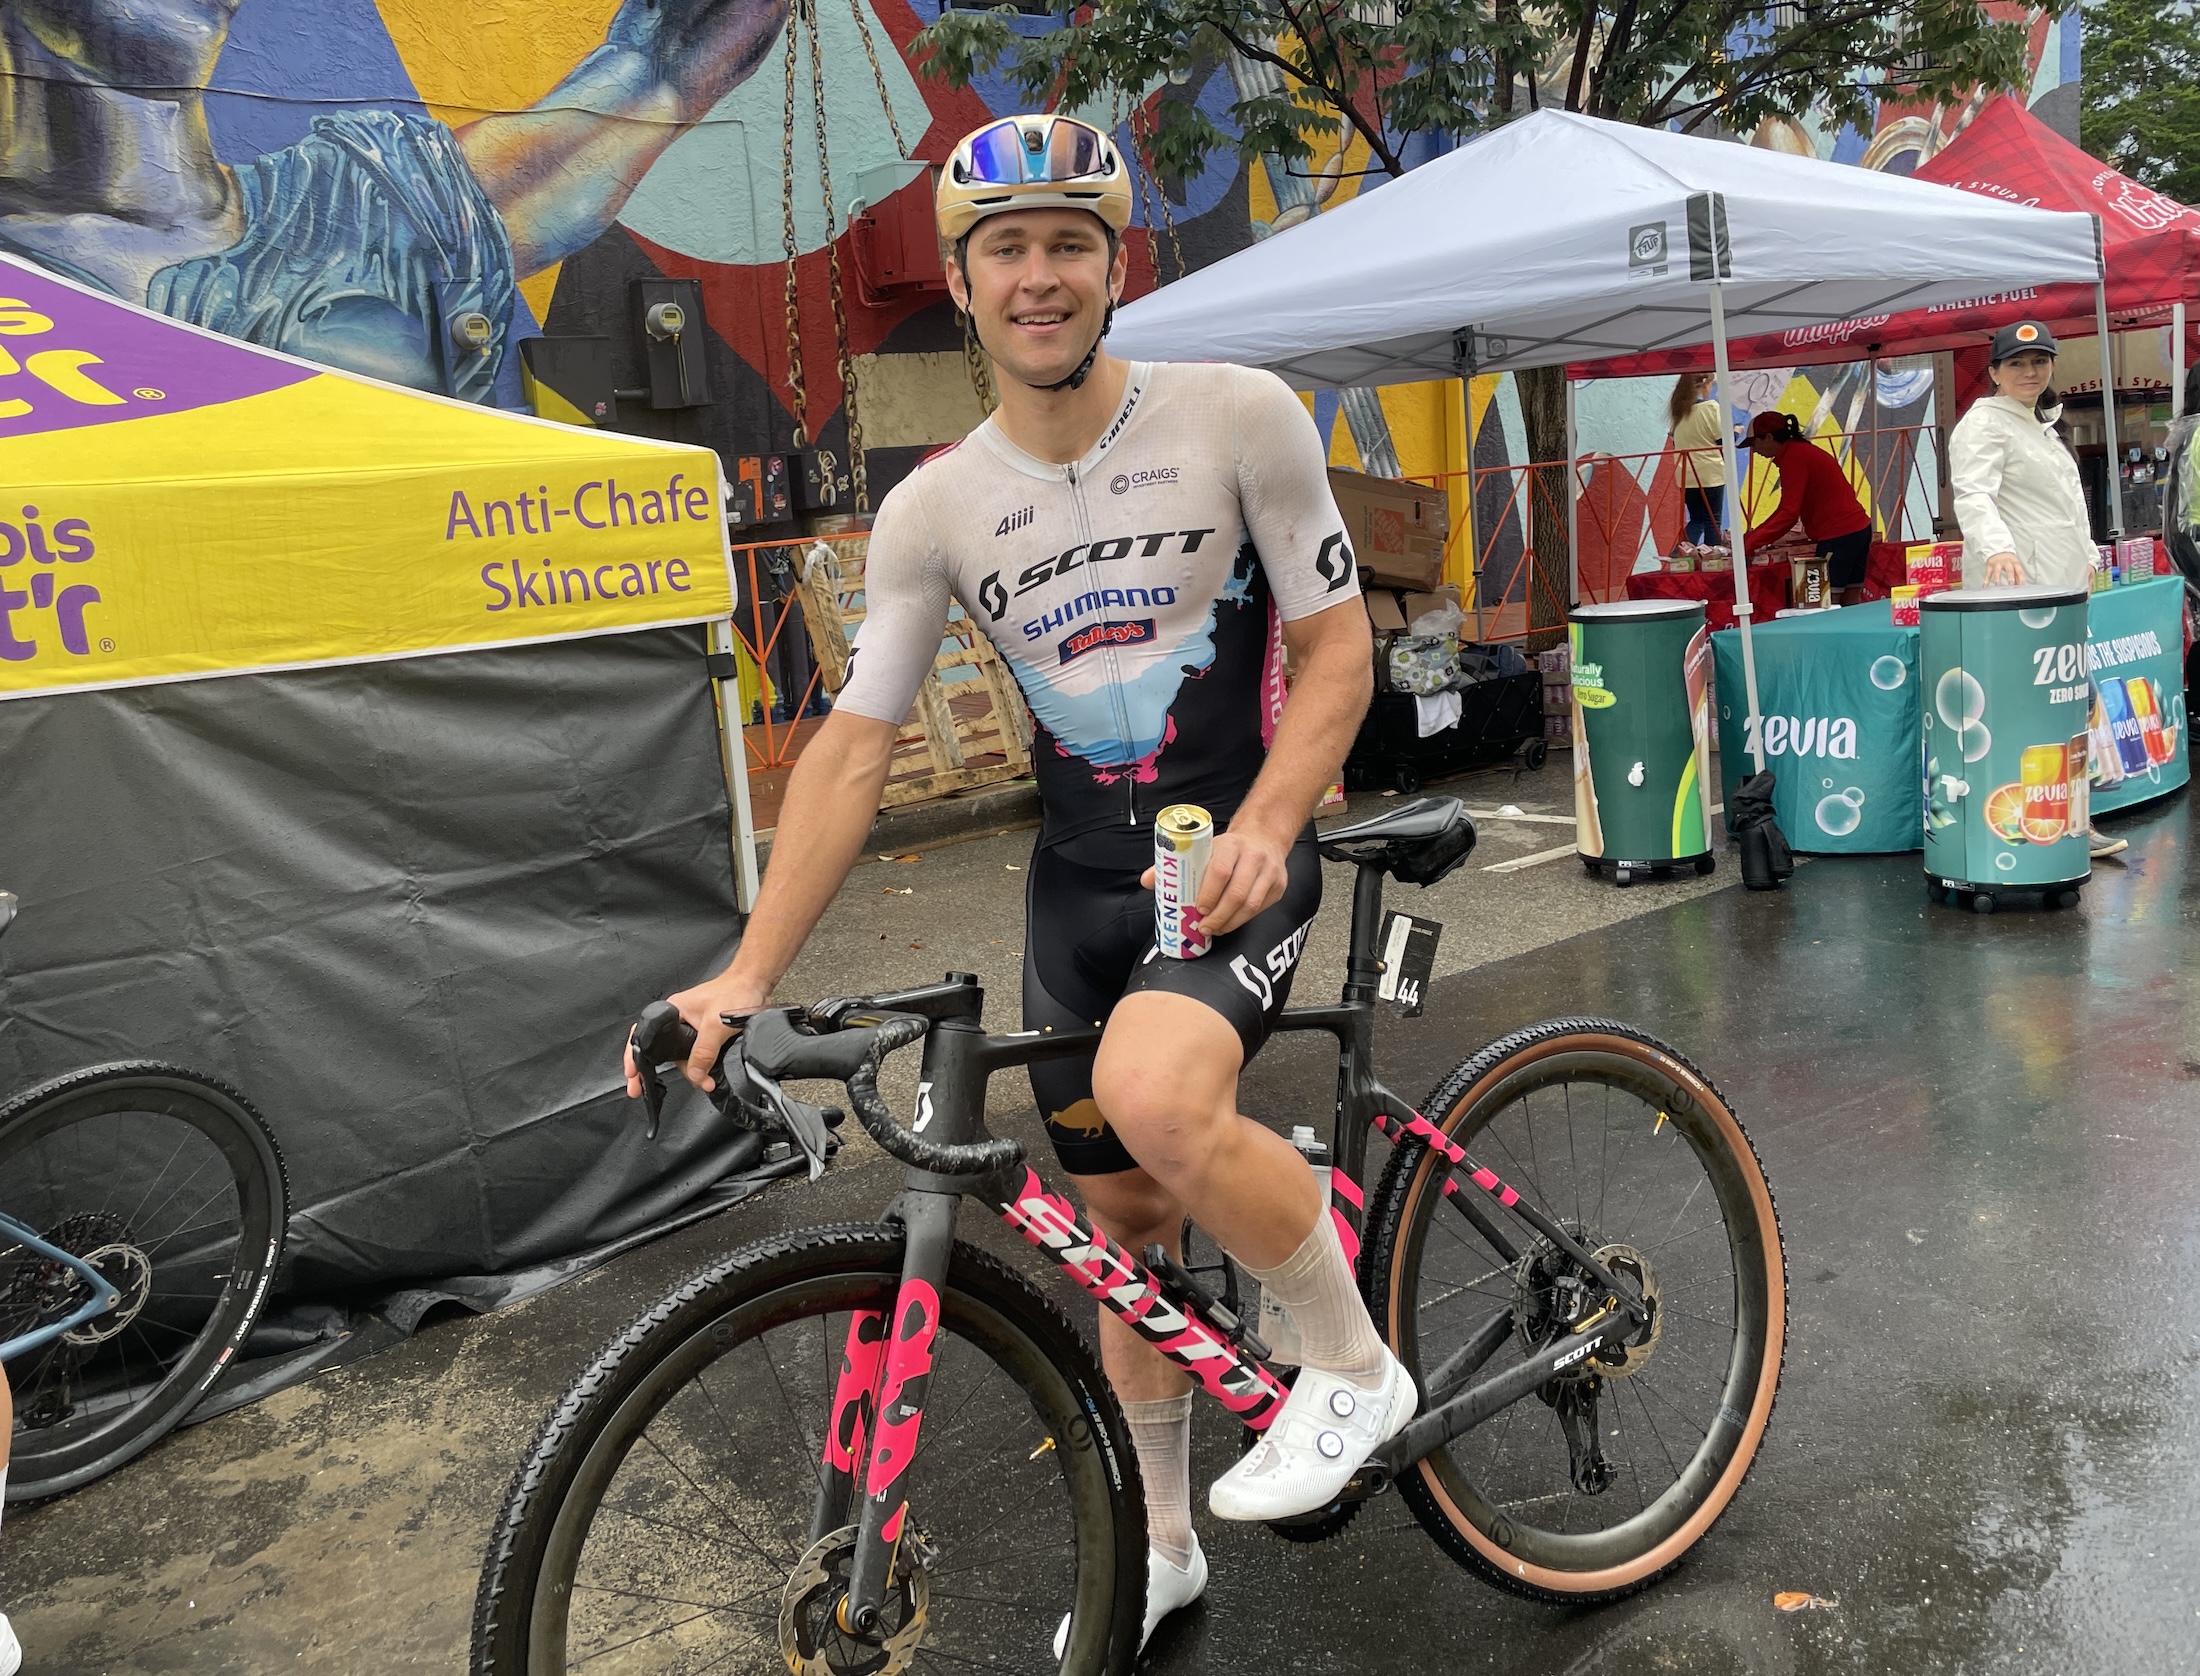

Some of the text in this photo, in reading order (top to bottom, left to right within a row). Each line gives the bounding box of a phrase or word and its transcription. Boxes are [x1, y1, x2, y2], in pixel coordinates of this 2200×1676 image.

[1970, 181, 2018, 201] SYRUP
[1927, 287, 2037, 314] ATHLETIC FUEL
[1132, 468, 1178, 484] CRAIGS
[446, 474, 710, 542] Anti-Chafe
[995, 506, 1034, 537] 4iiii
[1014, 528, 1216, 598] SCOTT
[1910, 556, 1943, 569] zevia
[480, 558, 691, 612] Skincare
[1023, 587, 1176, 641] SHIMANO
[2049, 687, 2073, 704] ZERO
[2025, 783, 2068, 803] zevia
[1163, 855, 1178, 948] KENETIK
[1397, 977, 1420, 1007] 44
[235, 1320, 249, 1341] DRY
[1553, 1336, 1603, 1371] SCOTT
